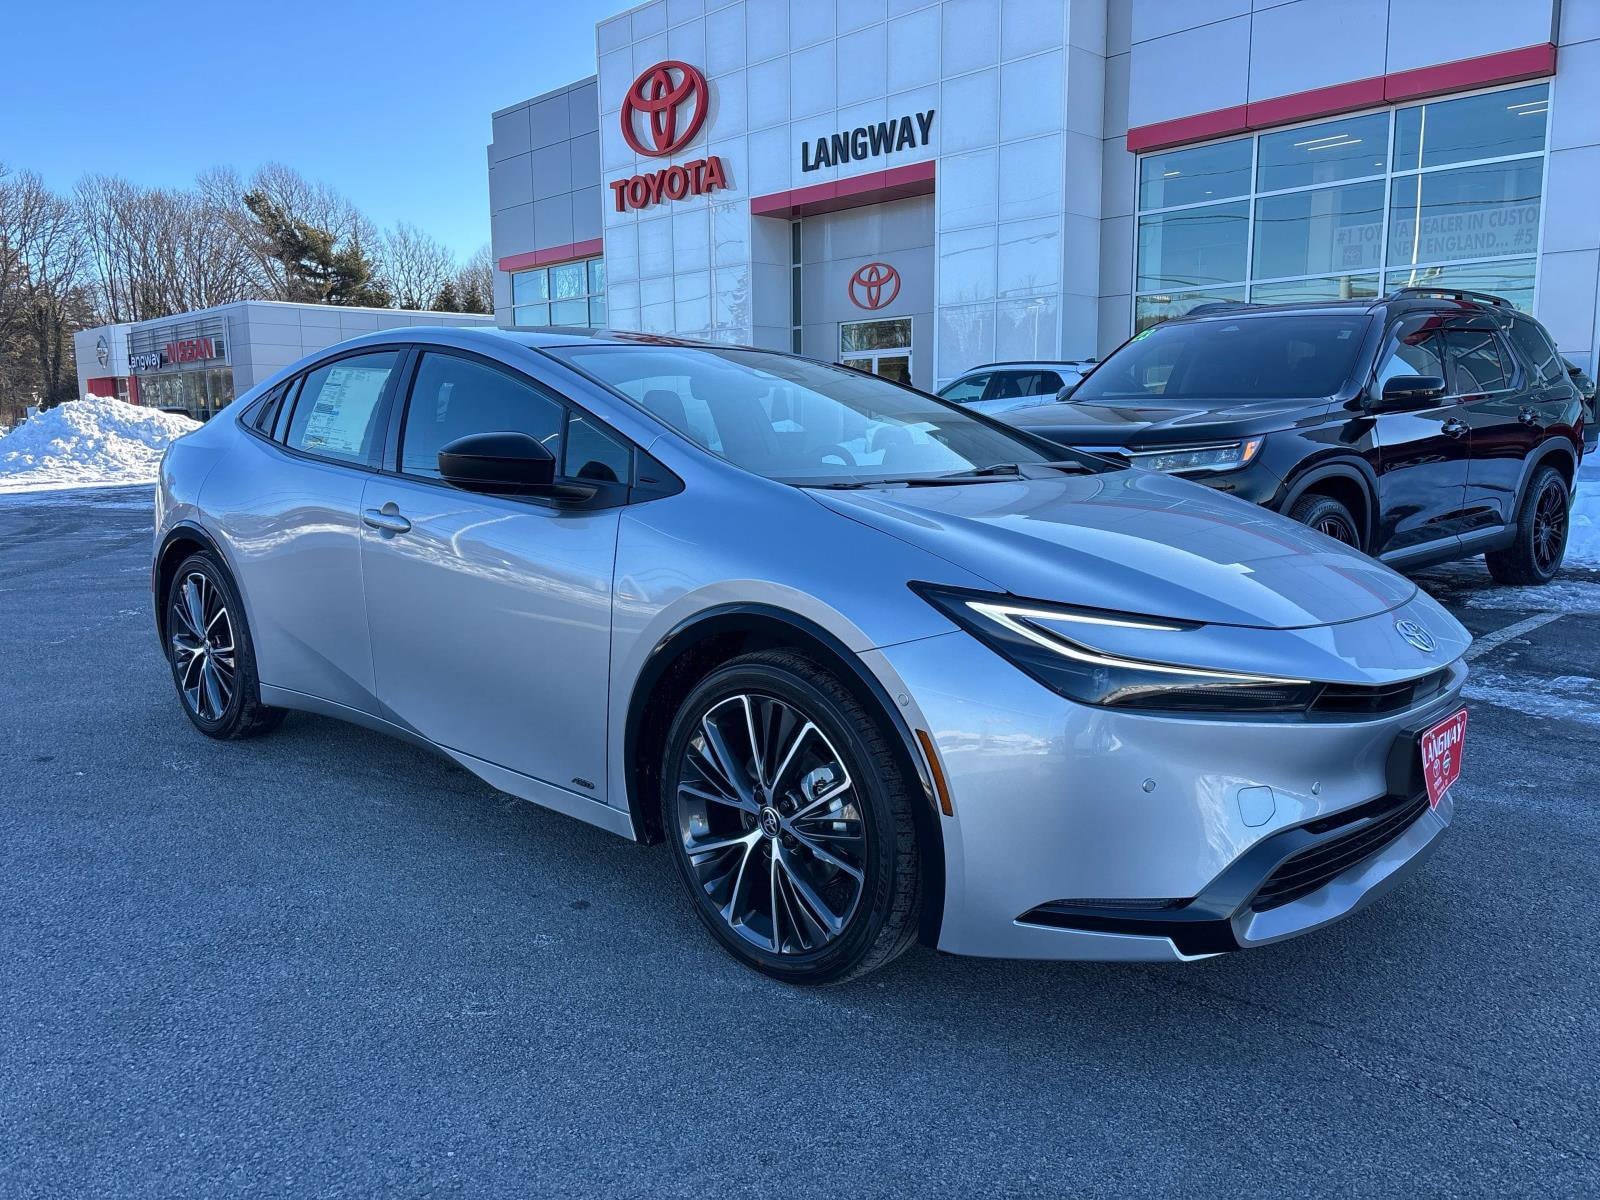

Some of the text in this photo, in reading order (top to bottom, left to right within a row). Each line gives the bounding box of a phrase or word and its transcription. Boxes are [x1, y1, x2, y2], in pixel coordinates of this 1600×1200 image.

[801, 109, 936, 173] LANGWAY
[610, 156, 727, 212] TOYOTA
[1359, 222, 1409, 243] TOYTA
[1414, 215, 1463, 236] EALER
[1468, 213, 1484, 231] IN
[1427, 231, 1508, 254] ENGLAND...
[1513, 228, 1533, 247] #5
[128, 338, 216, 370] Langway NISSAN
[1423, 721, 1464, 769] LANGWAY
